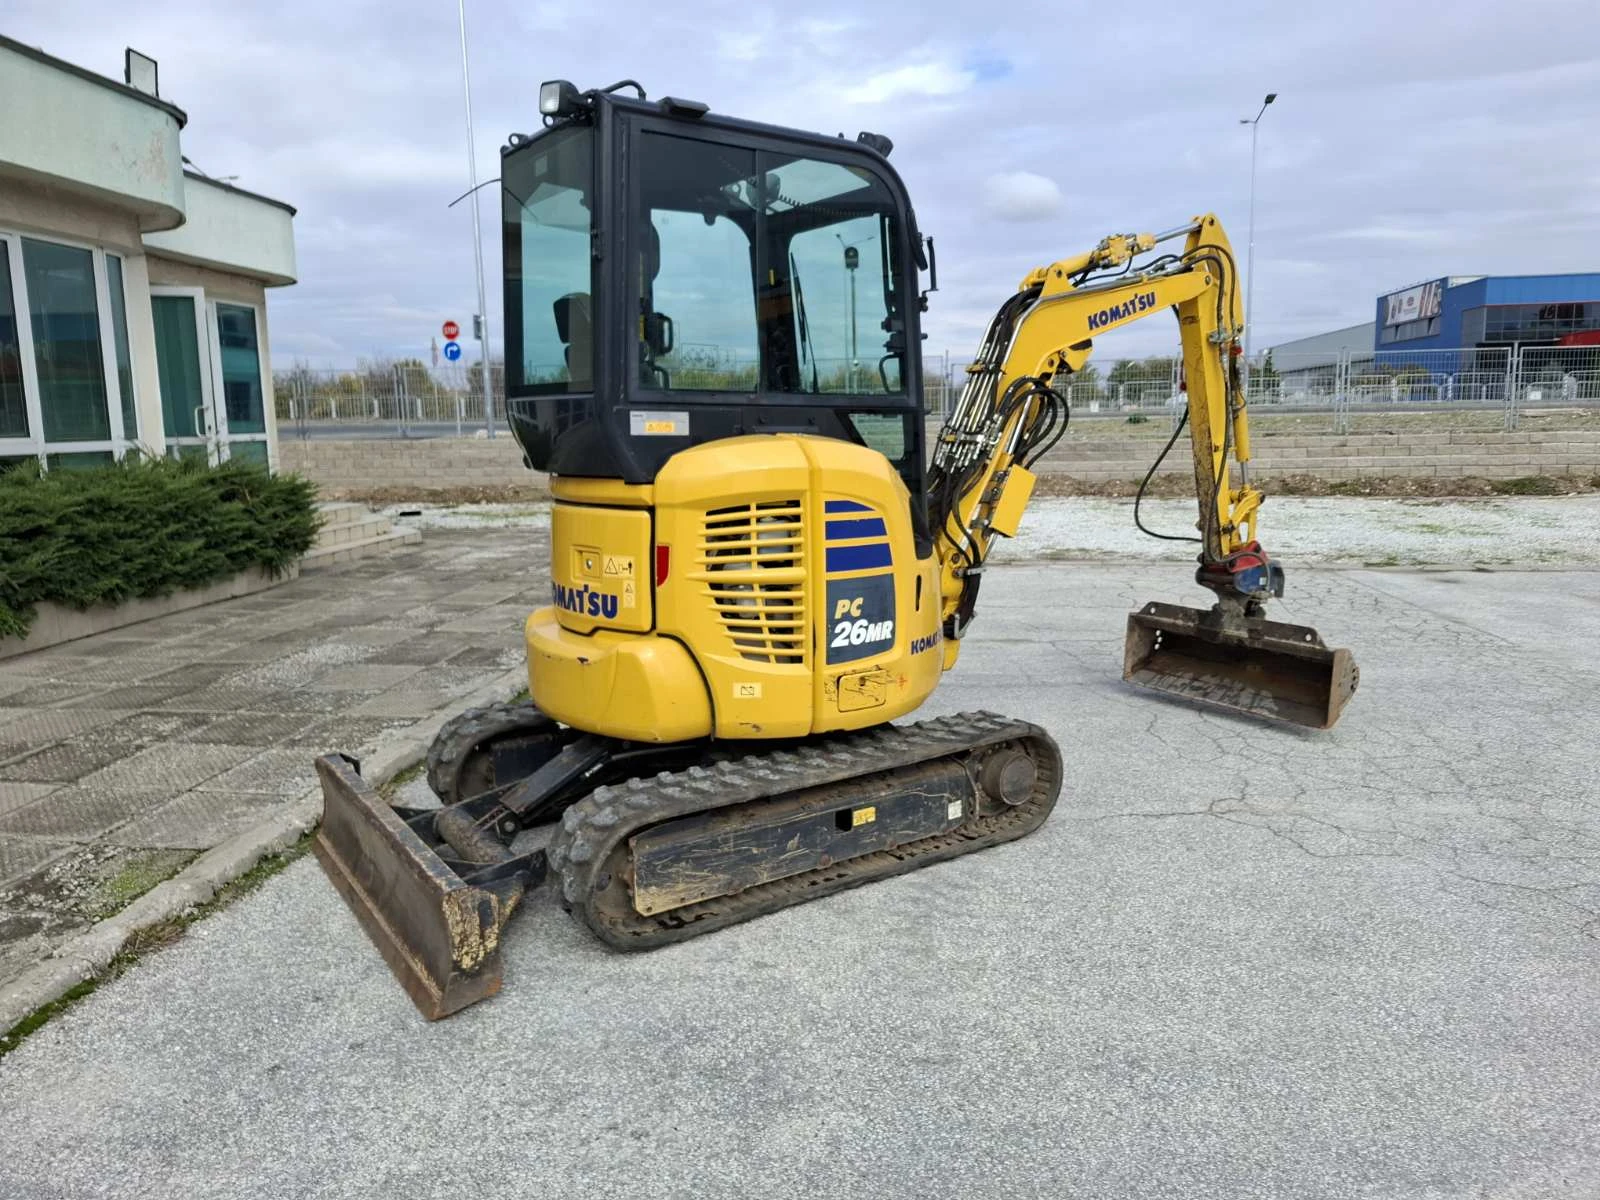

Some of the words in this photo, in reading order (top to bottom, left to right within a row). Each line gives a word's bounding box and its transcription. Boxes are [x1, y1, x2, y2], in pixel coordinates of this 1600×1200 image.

[1088, 292, 1156, 330] KOMATSU
[834, 597, 864, 619] PC
[831, 619, 894, 648] 26MR
